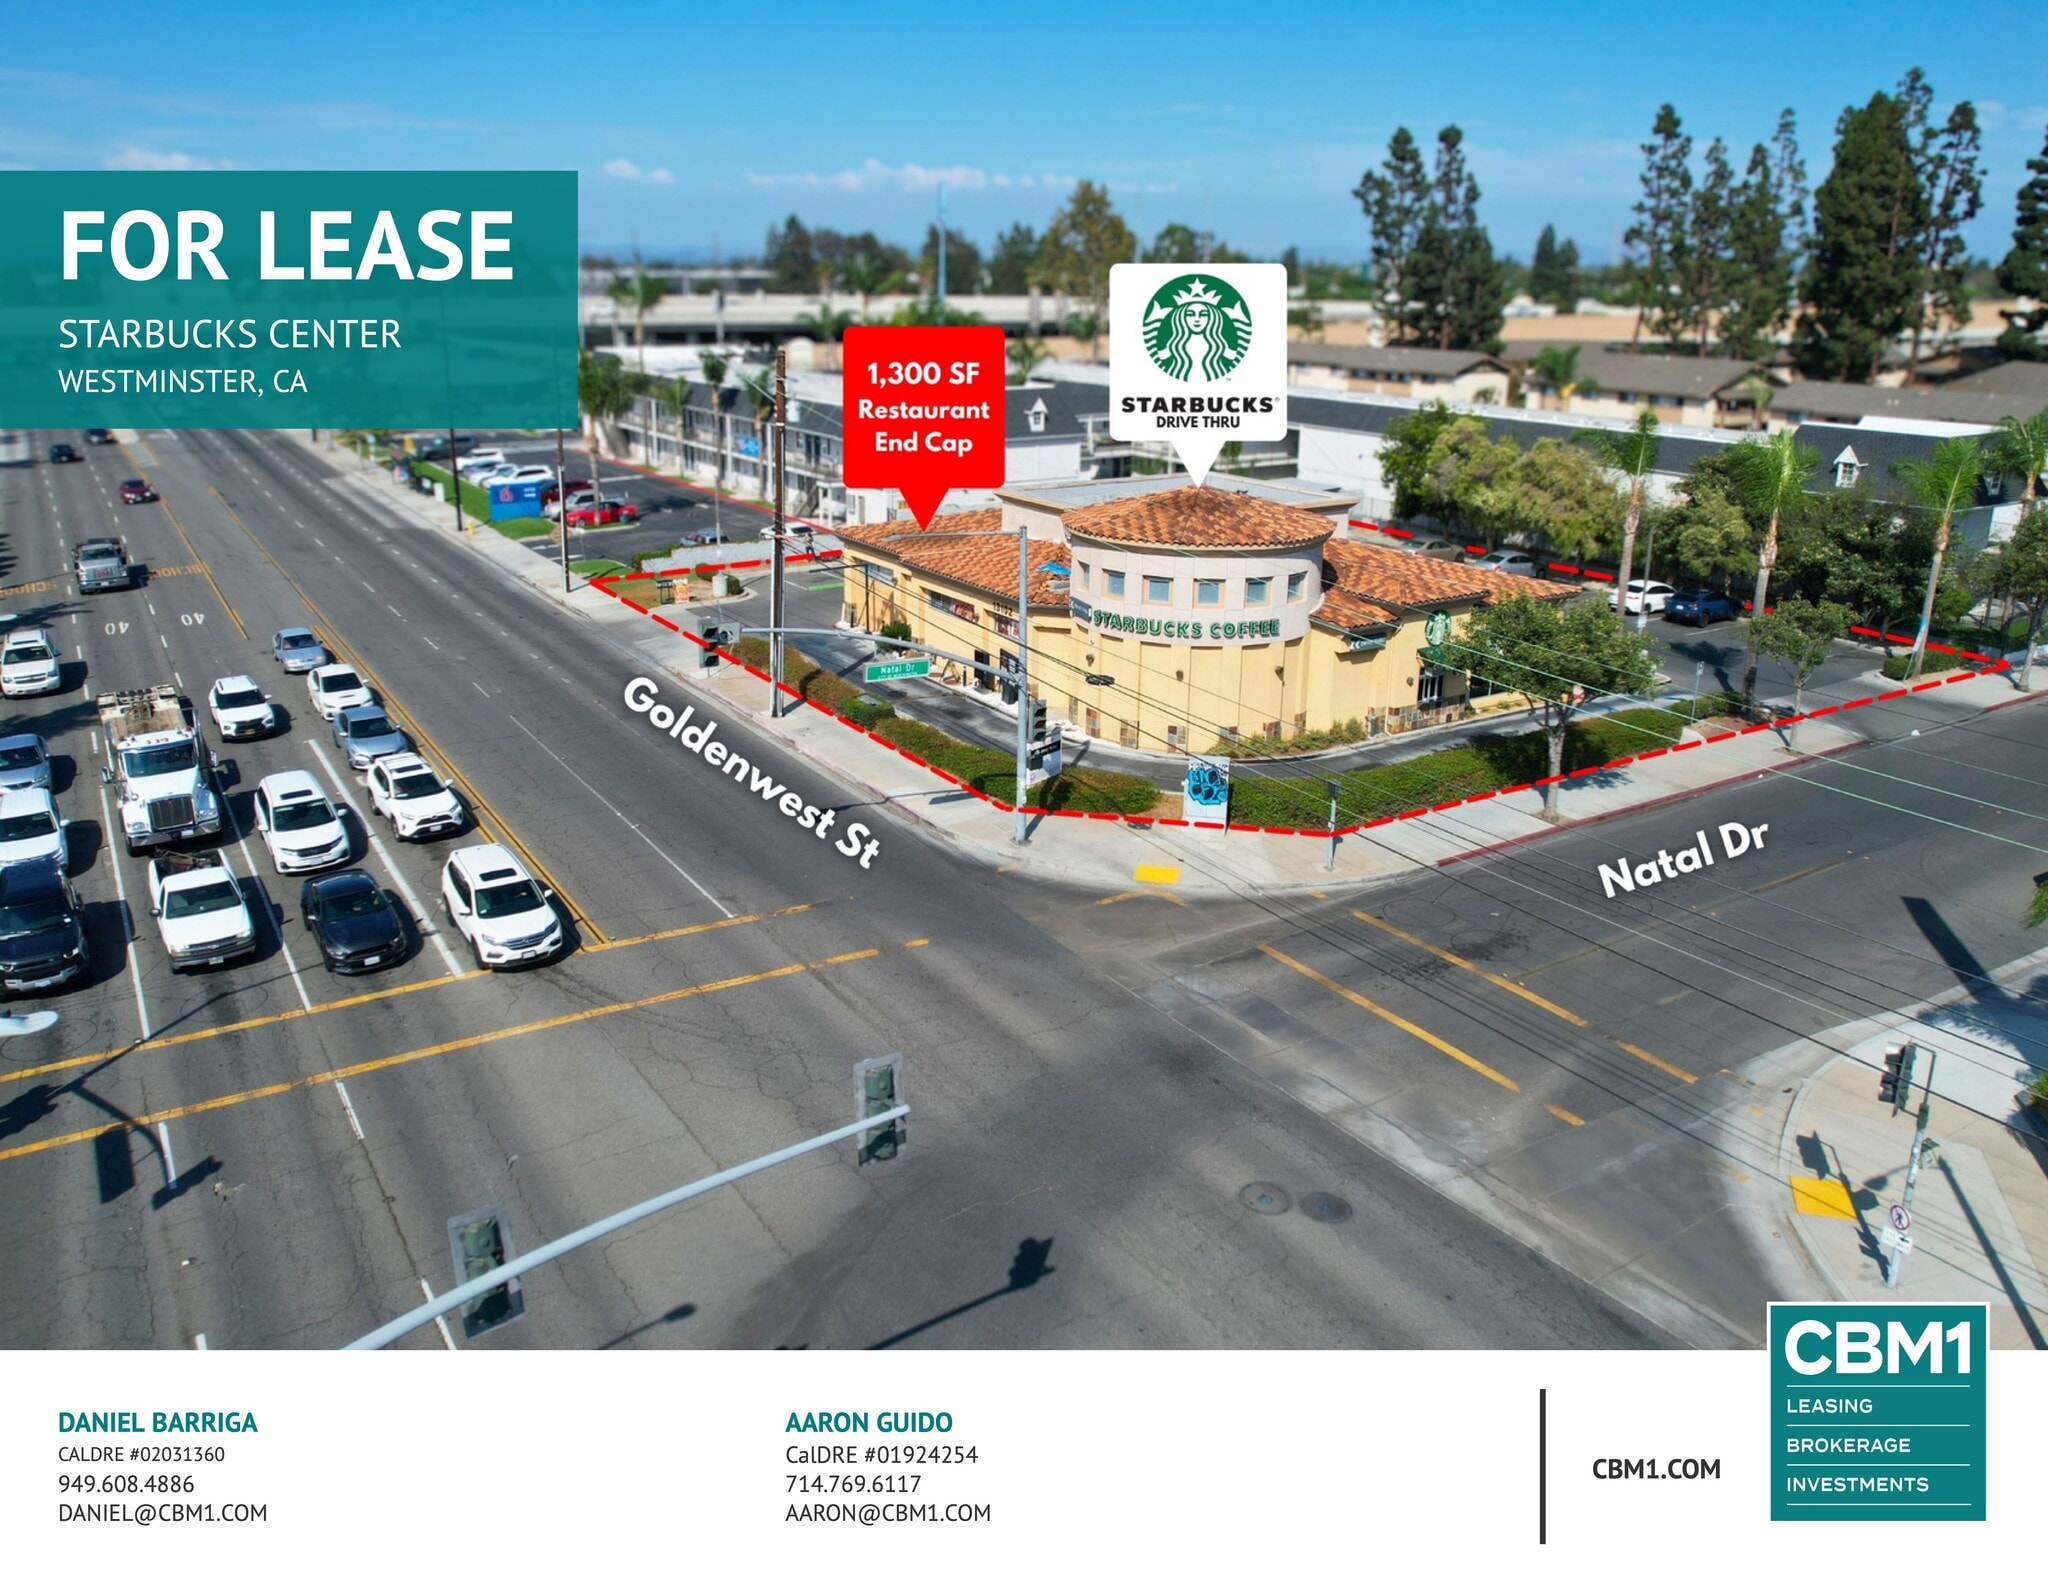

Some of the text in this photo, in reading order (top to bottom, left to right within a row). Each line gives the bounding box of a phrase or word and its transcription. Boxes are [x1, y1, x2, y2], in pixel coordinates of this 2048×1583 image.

[181, 612, 205, 627] 40
[1093, 609, 1281, 640] STARBUCKS COFFEE
[105, 621, 129, 635] 40
[880, 663, 915, 674] Natal Dr
